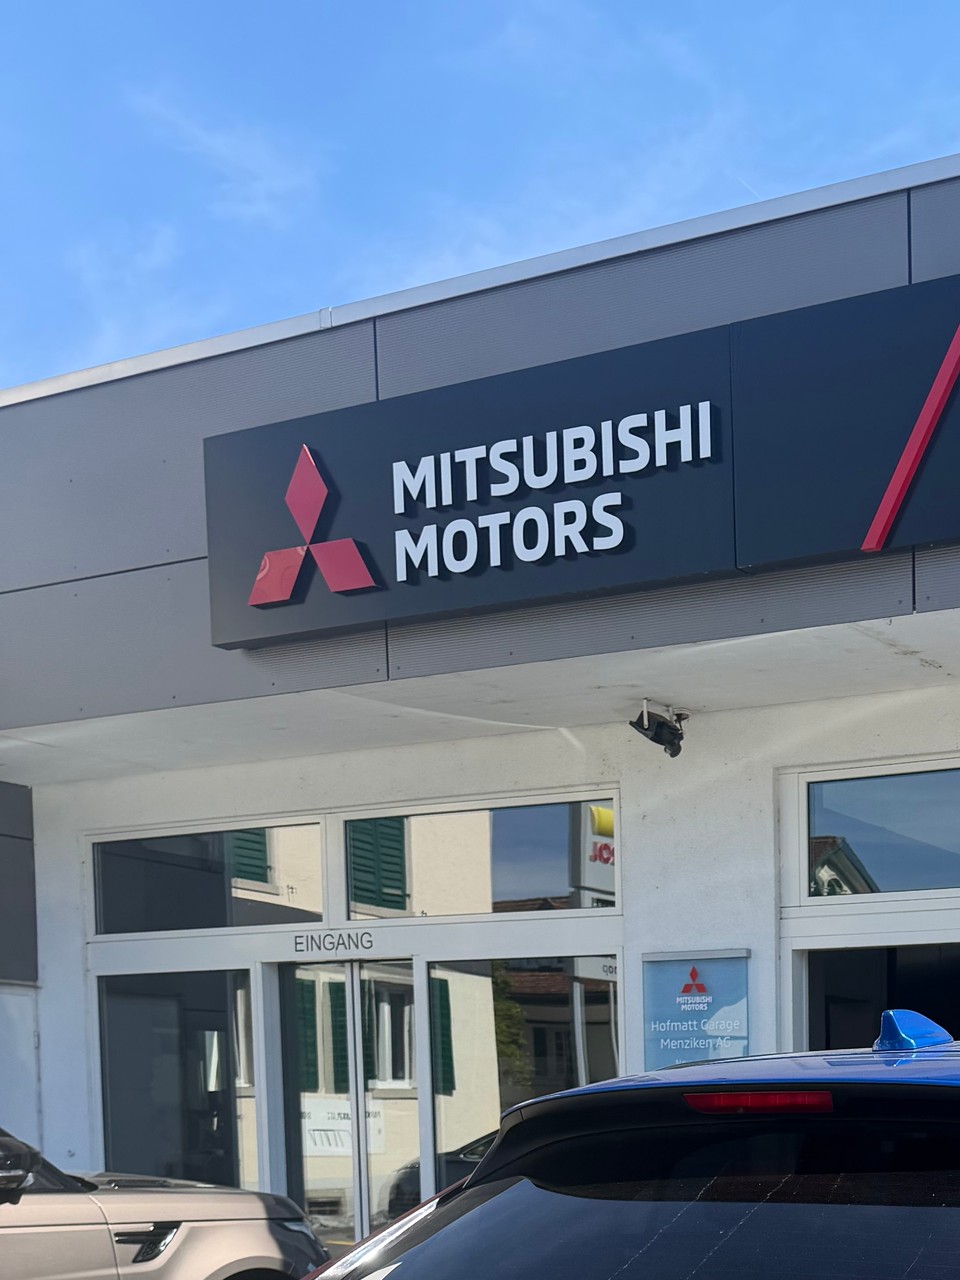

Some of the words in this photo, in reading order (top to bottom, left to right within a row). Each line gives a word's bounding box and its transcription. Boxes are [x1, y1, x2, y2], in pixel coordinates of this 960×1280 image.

[392, 400, 712, 515] MITSUBISHI
[395, 492, 625, 582] MOTORS
[294, 932, 373, 952] EINGANG
[676, 996, 713, 1004] MITSUBISHI
[681, 1003, 708, 1011] MOTORS
[651, 1019, 698, 1032] Hofmatt
[701, 1019, 740, 1032] Garage
[660, 1036, 712, 1049] Menziken
[715, 1036, 731, 1048] AG
